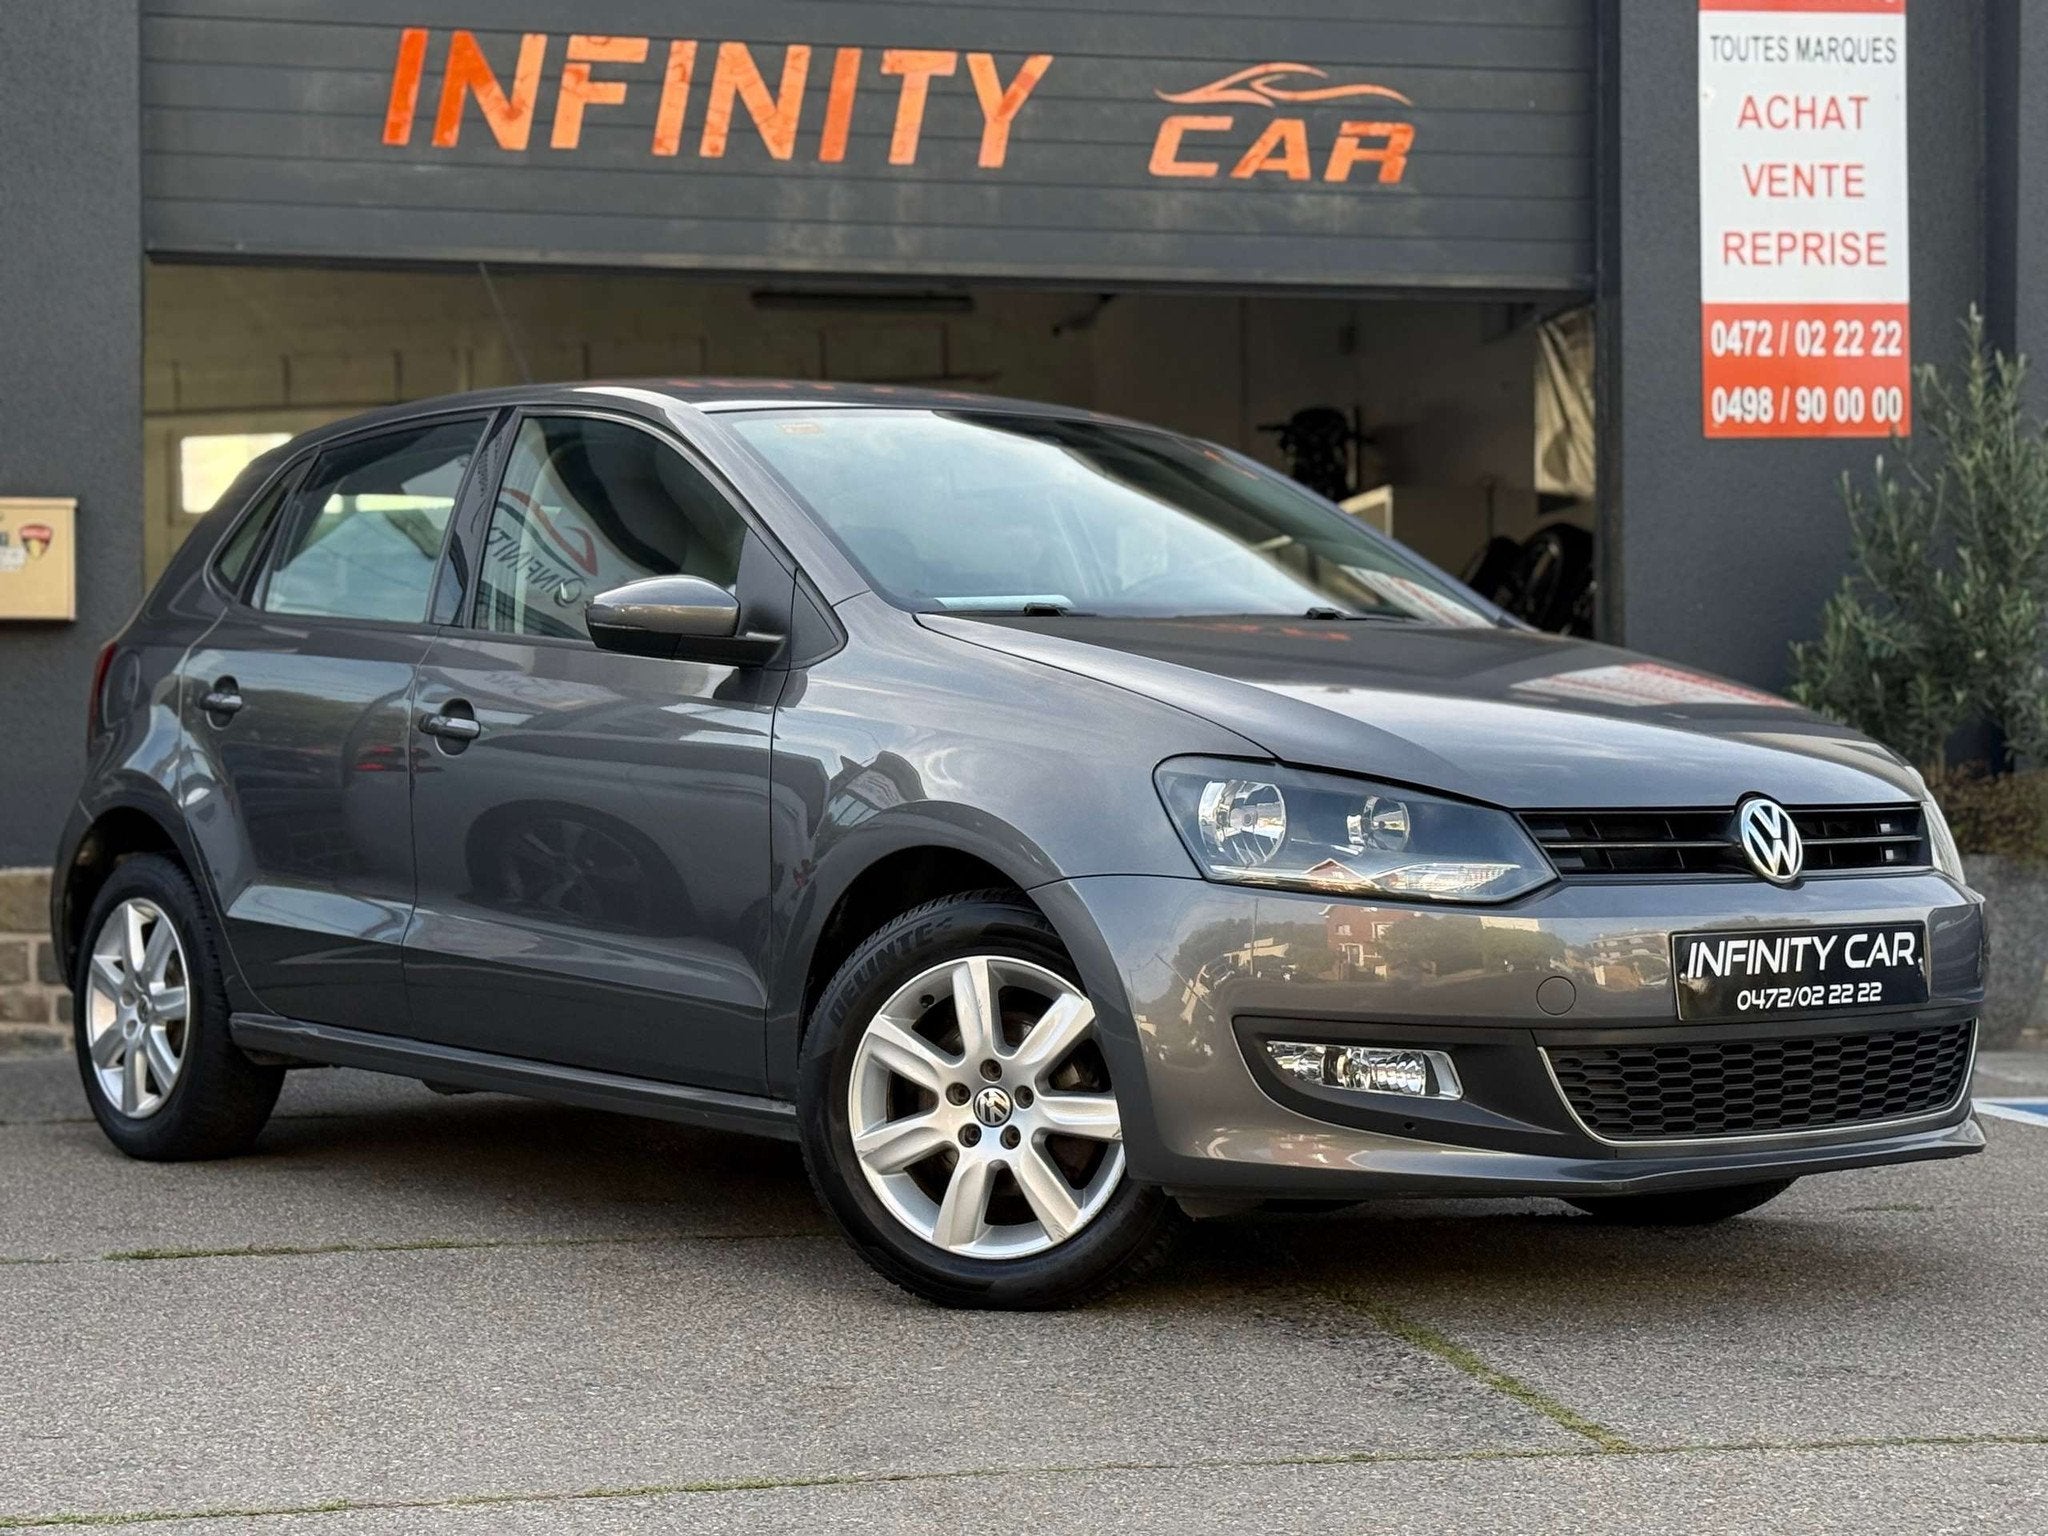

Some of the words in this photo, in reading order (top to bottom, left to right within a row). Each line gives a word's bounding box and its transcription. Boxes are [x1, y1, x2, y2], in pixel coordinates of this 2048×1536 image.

[1710, 35, 1789, 62] TOUTES
[1797, 37, 1897, 64] MARQUES
[382, 27, 1053, 169] INFINITY
[1148, 115, 1415, 184] CAR
[1738, 95, 1868, 130] ACHAT
[1743, 163, 1865, 198] VENTE
[1723, 231, 1888, 267] REPRISE
[1711, 319, 1773, 357] 0472
[1795, 319, 1827, 357] 02
[1833, 319, 1864, 357] 22
[1871, 319, 1902, 357] 22
[1712, 386, 1774, 424] 0498
[1795, 386, 1827, 424] 90
[1834, 386, 1865, 424] 00
[1872, 386, 1903, 424] 00
[1687, 934, 1838, 979] INFINITY
[1844, 931, 1916, 969] CAR
[1737, 985, 1824, 1011] 0472/02
[1828, 983, 1854, 1005] 22
[1857, 981, 1882, 1003] 22
